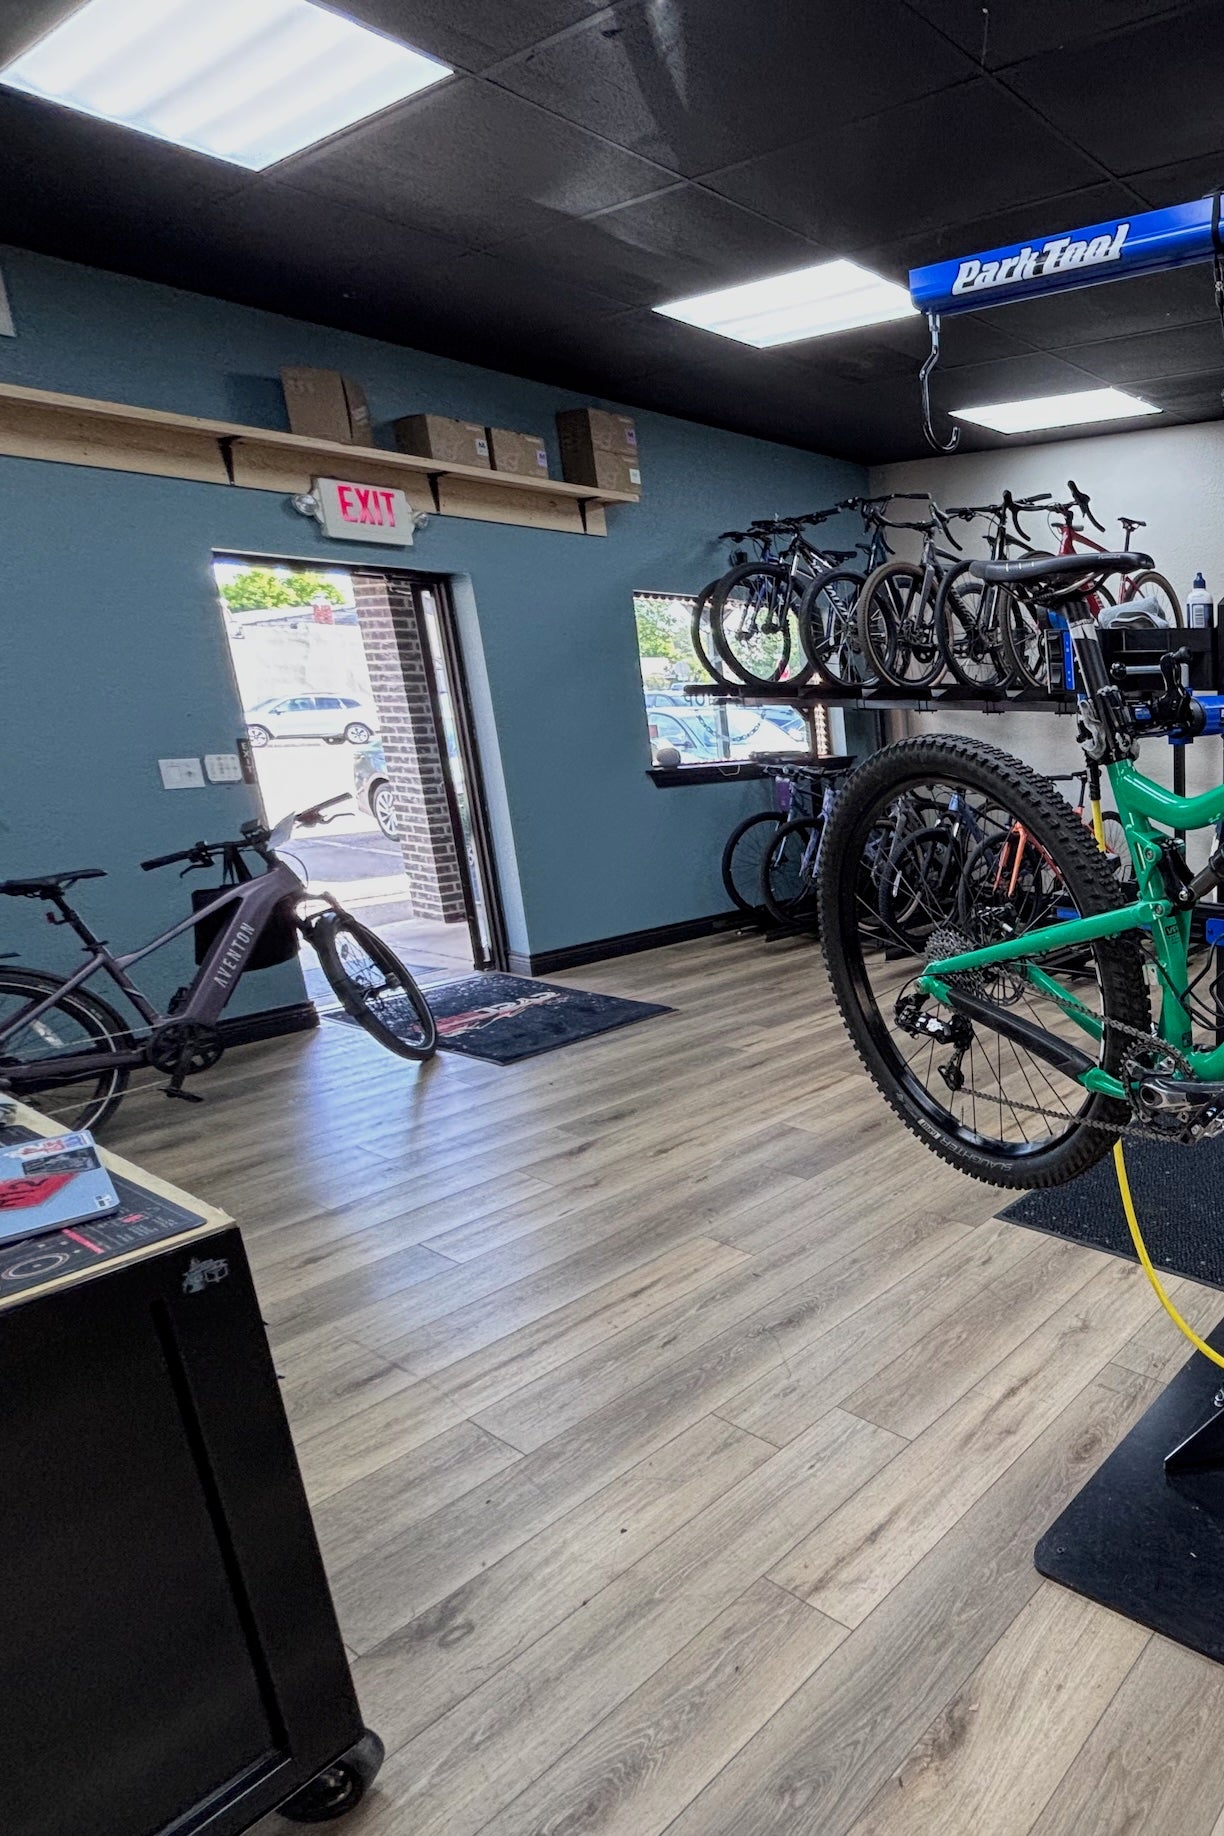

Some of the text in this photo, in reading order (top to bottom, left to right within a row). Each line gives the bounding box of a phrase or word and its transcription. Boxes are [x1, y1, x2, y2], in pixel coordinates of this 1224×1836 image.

[337, 484, 395, 528] EXIT
[240, 742, 254, 776] EXIT
[213, 921, 256, 988] AVENTON
[940, 1137, 1014, 1172] SLAUGHTER
